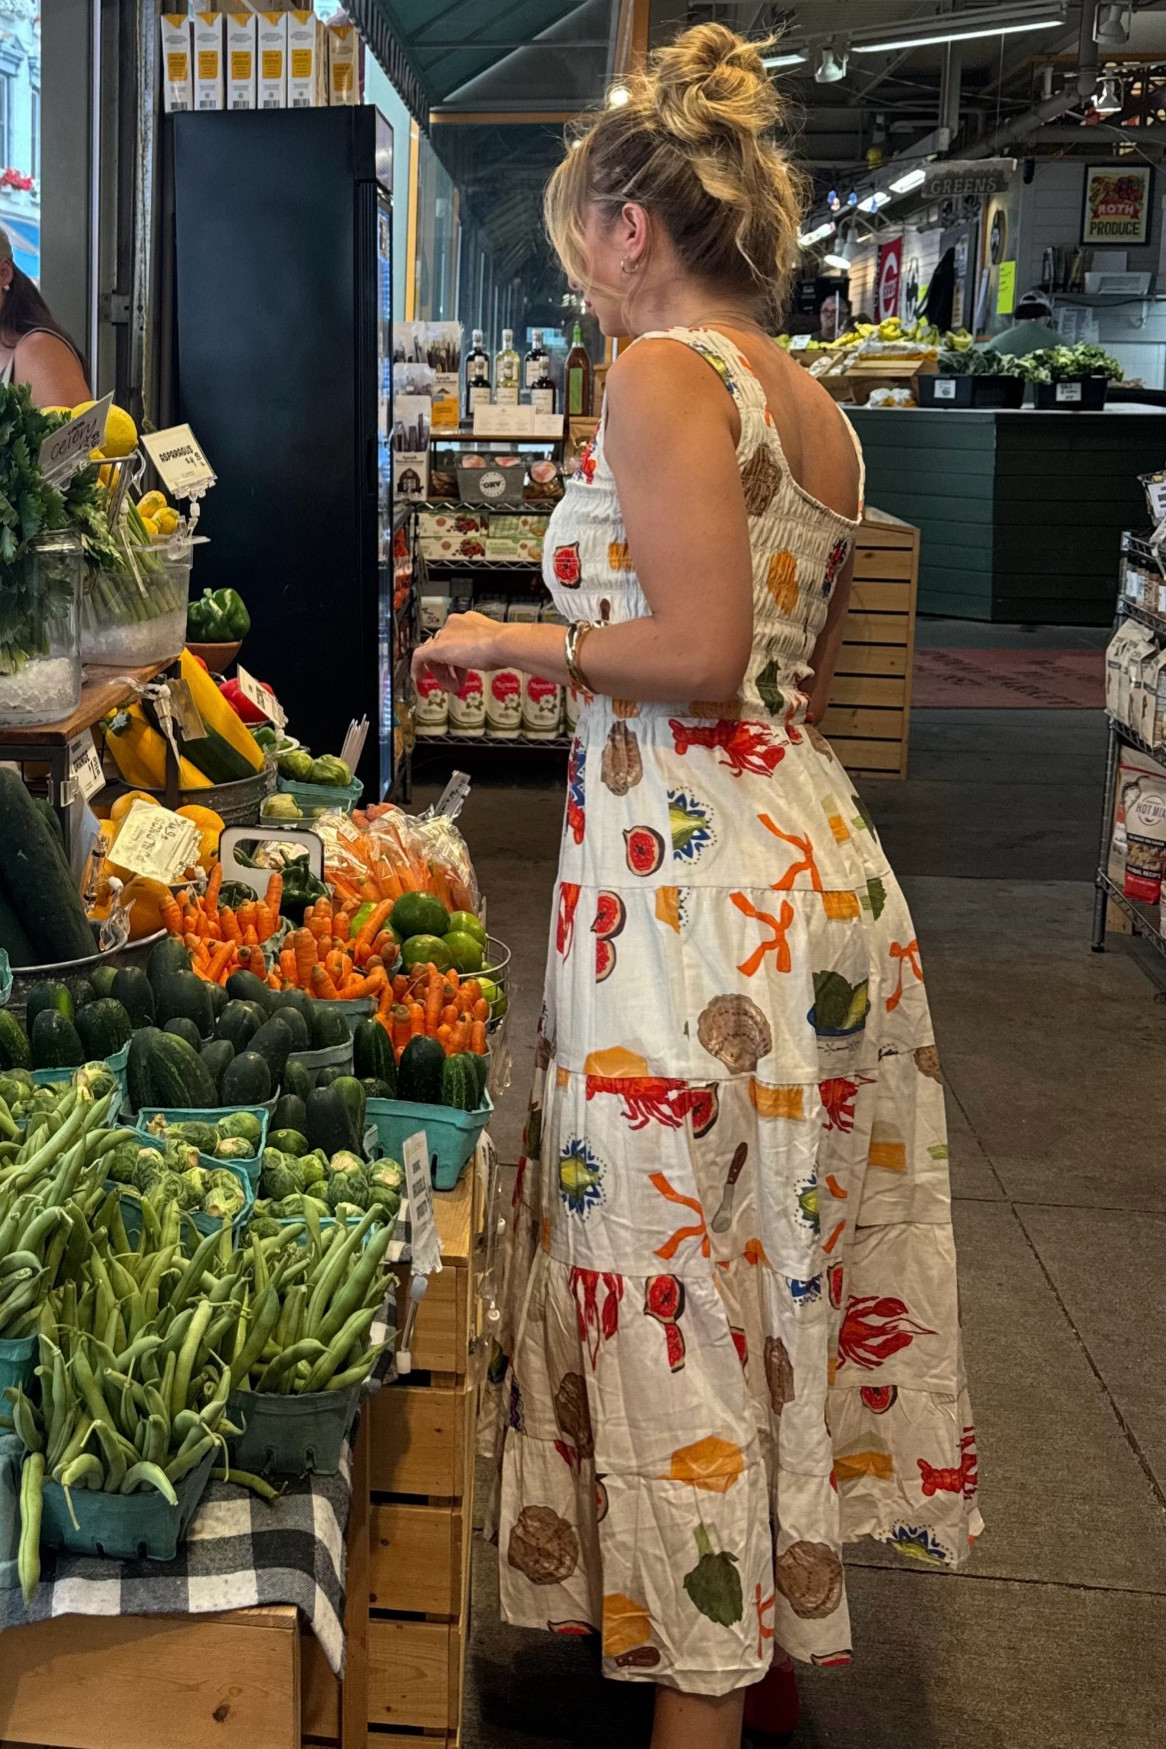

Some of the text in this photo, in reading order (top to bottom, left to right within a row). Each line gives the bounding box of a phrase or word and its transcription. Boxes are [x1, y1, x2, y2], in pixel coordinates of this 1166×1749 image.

[930, 176, 997, 195] GREENS
[1097, 203, 1135, 214] ROTH
[1089, 221, 1141, 236] PRODUCE
[158, 444, 194, 463] ASPARAGUS
[1135, 802, 1152, 815] HOT
